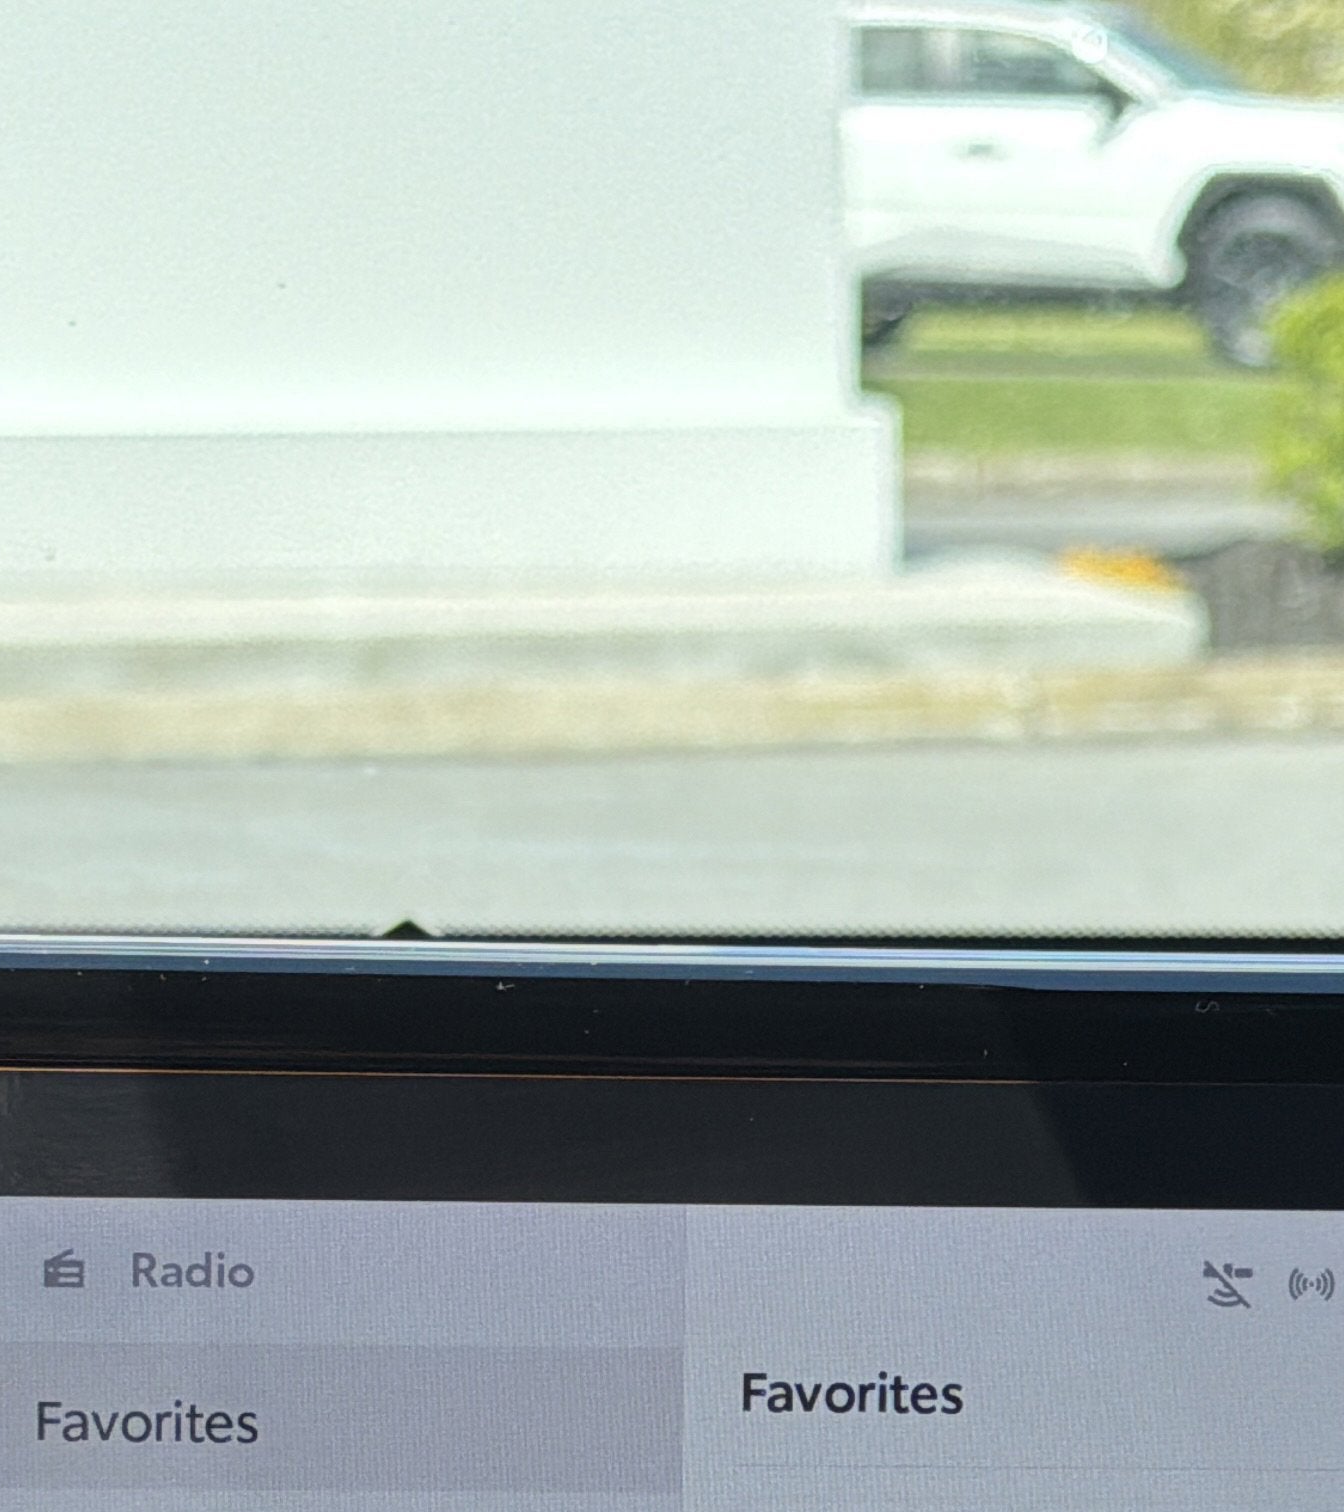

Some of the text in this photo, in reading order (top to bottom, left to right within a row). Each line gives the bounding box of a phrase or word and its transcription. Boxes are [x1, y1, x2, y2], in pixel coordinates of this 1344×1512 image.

[131, 1251, 255, 1289] Radio
[742, 1370, 964, 1415] Favorites
[37, 1399, 259, 1445] Favorites
